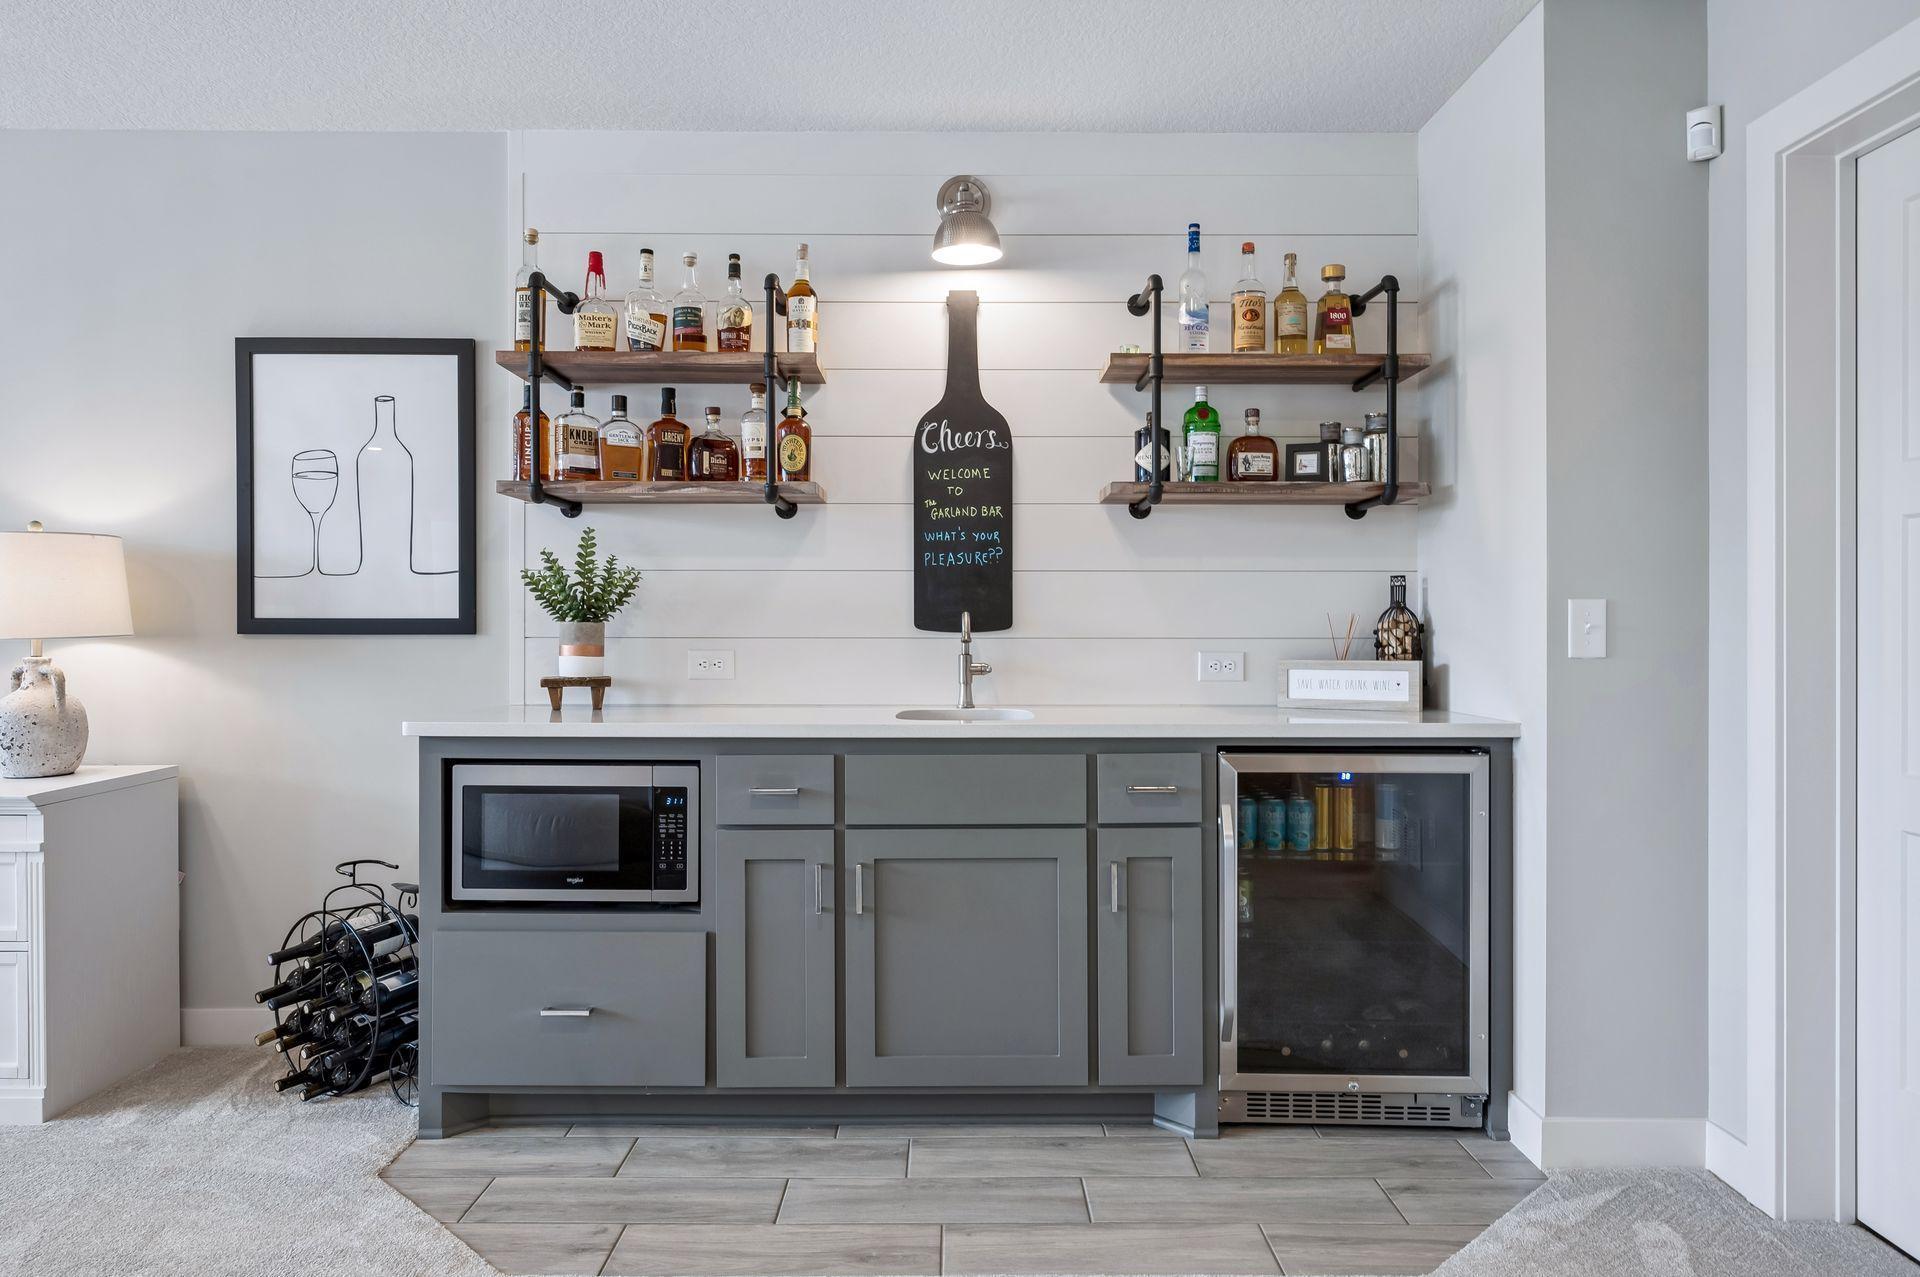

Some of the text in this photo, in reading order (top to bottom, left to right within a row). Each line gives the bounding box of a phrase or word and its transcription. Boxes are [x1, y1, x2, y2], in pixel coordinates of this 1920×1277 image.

[1240, 299, 1263, 307] Tito's
[578, 314, 612, 323] Maker's
[587, 321, 612, 330] Mark
[569, 428, 593, 442] KNOB
[920, 419, 1010, 454] Cheers
[928, 467, 991, 481] WELCOME
[947, 486, 963, 496] TO
[930, 505, 1003, 521] GARLAND BAR
[924, 527, 1001, 543] WHAT'S YOUR
